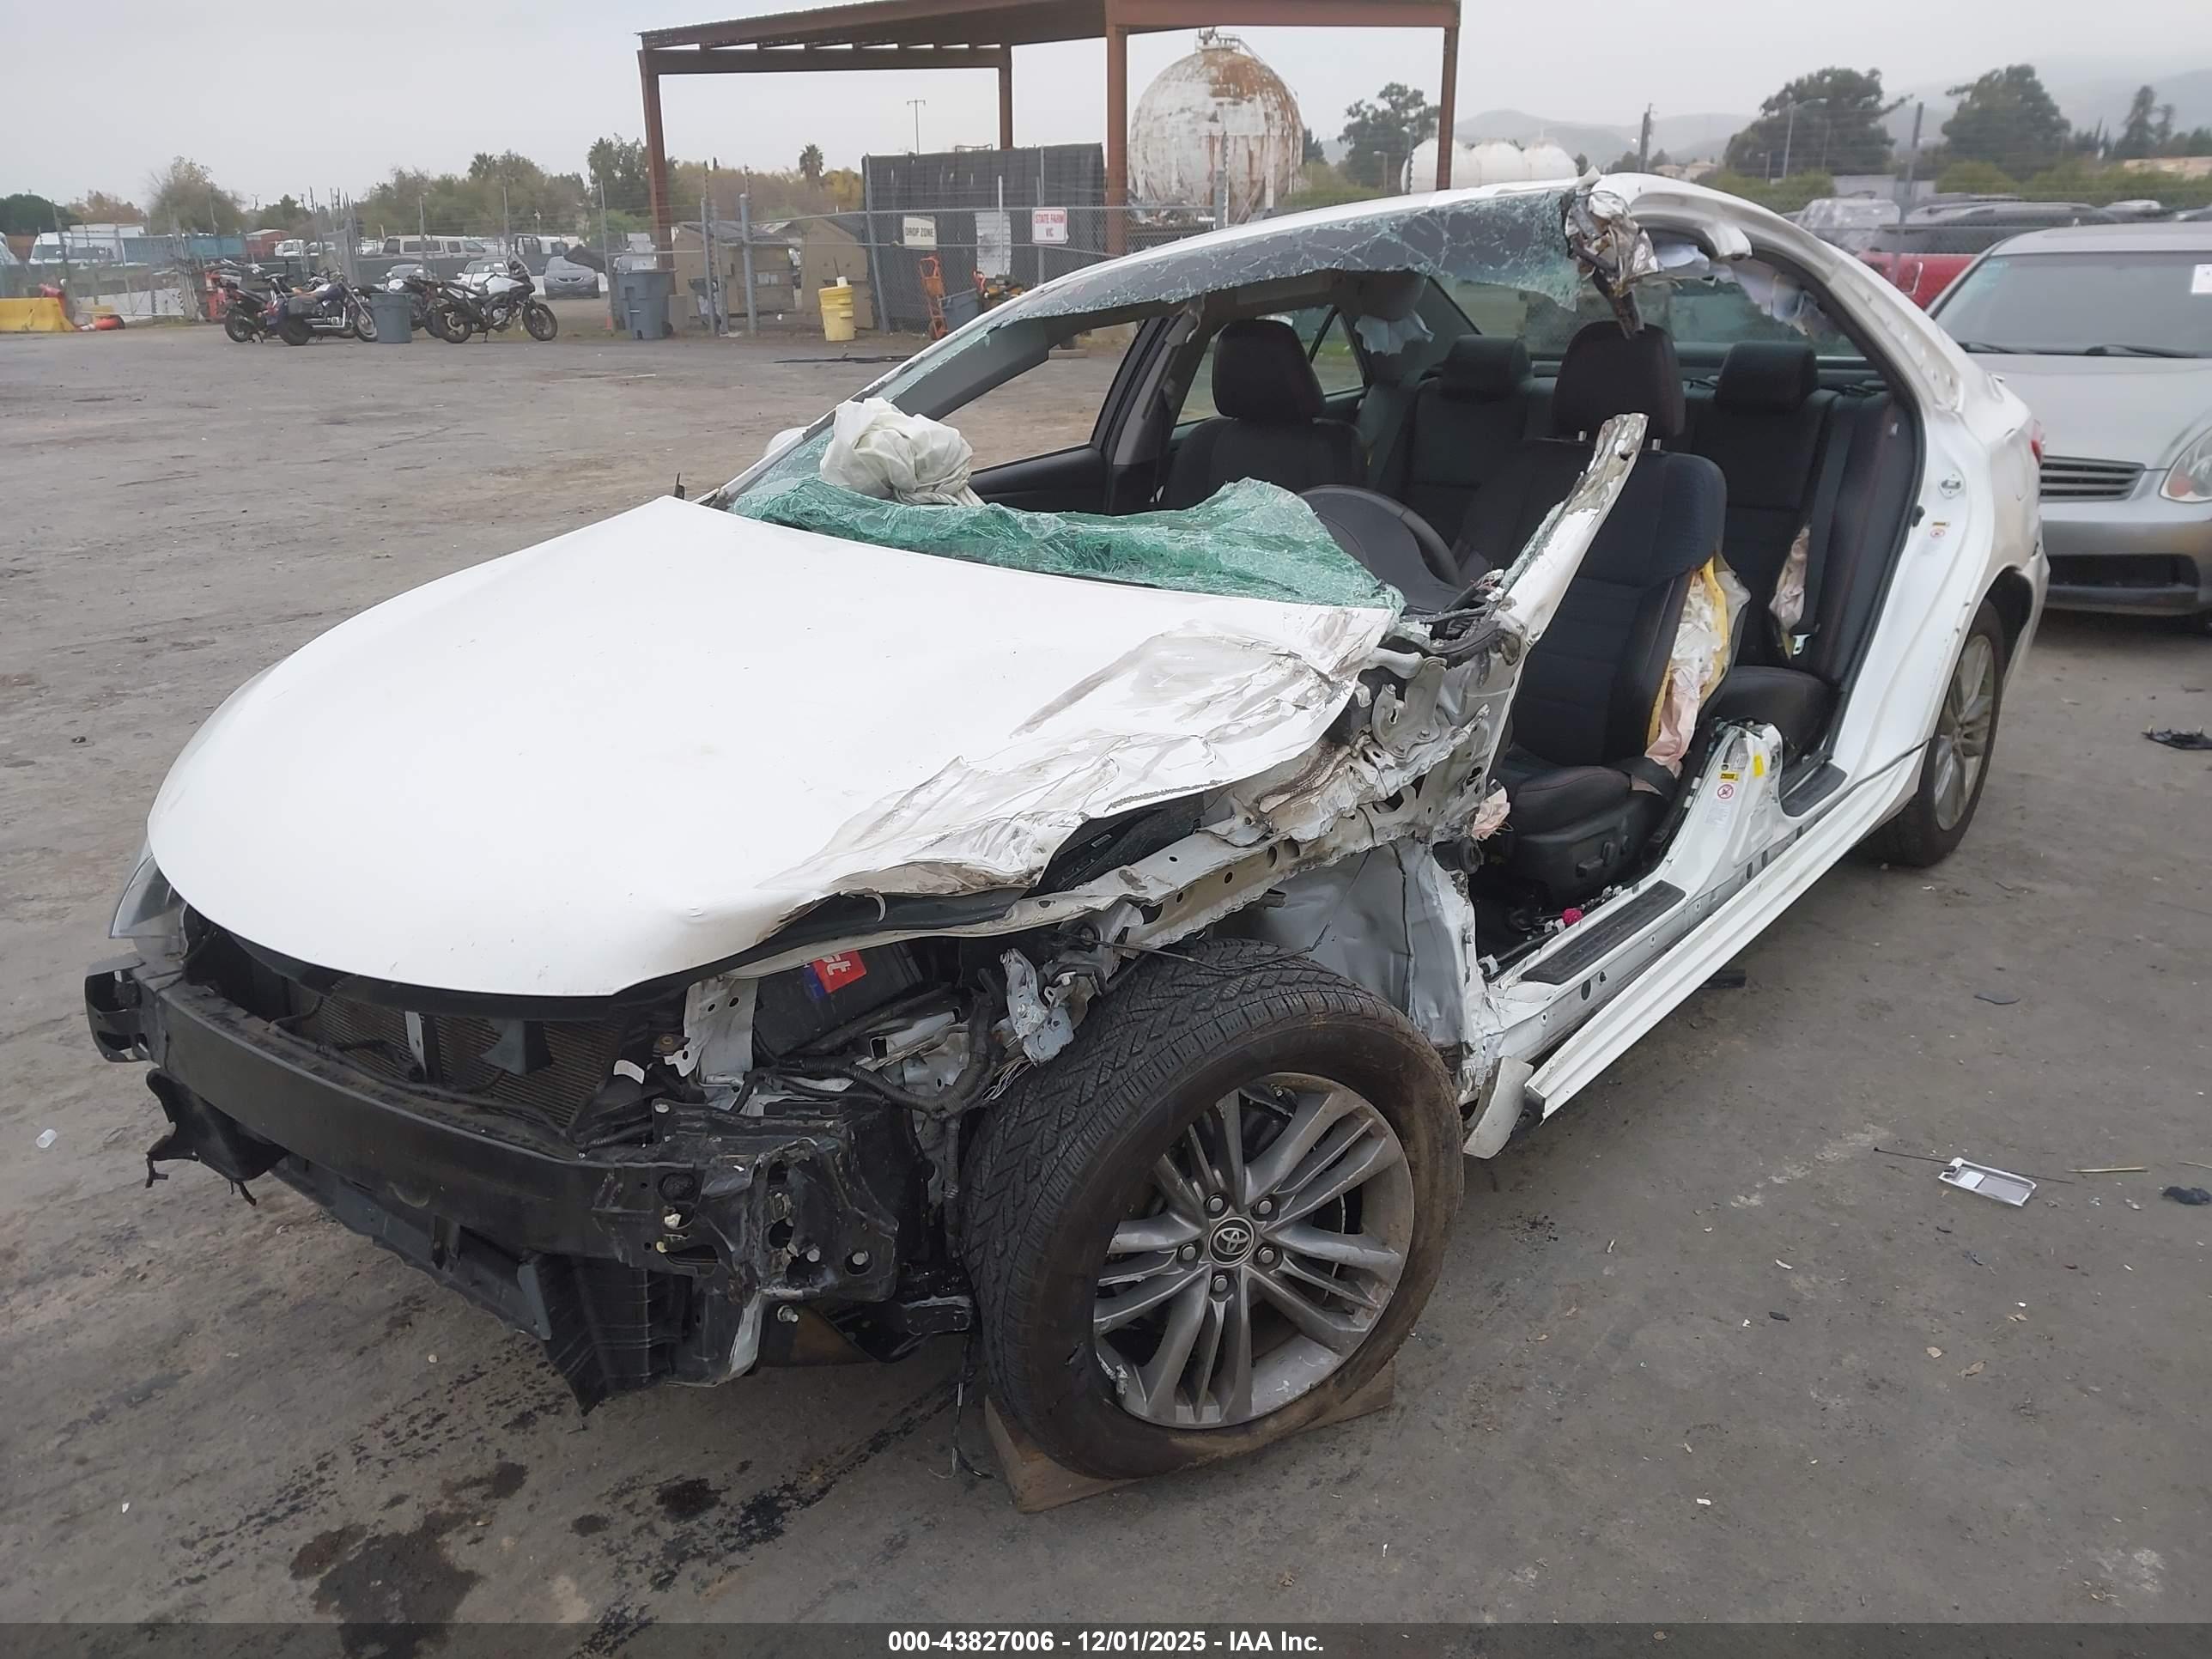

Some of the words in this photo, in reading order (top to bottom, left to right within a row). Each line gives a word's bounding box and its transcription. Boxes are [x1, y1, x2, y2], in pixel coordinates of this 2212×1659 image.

[1036, 213, 1049, 224] STATE
[1050, 213, 1065, 224] FARM
[905, 227, 920, 236] DROP
[921, 227, 934, 237] ZONE
